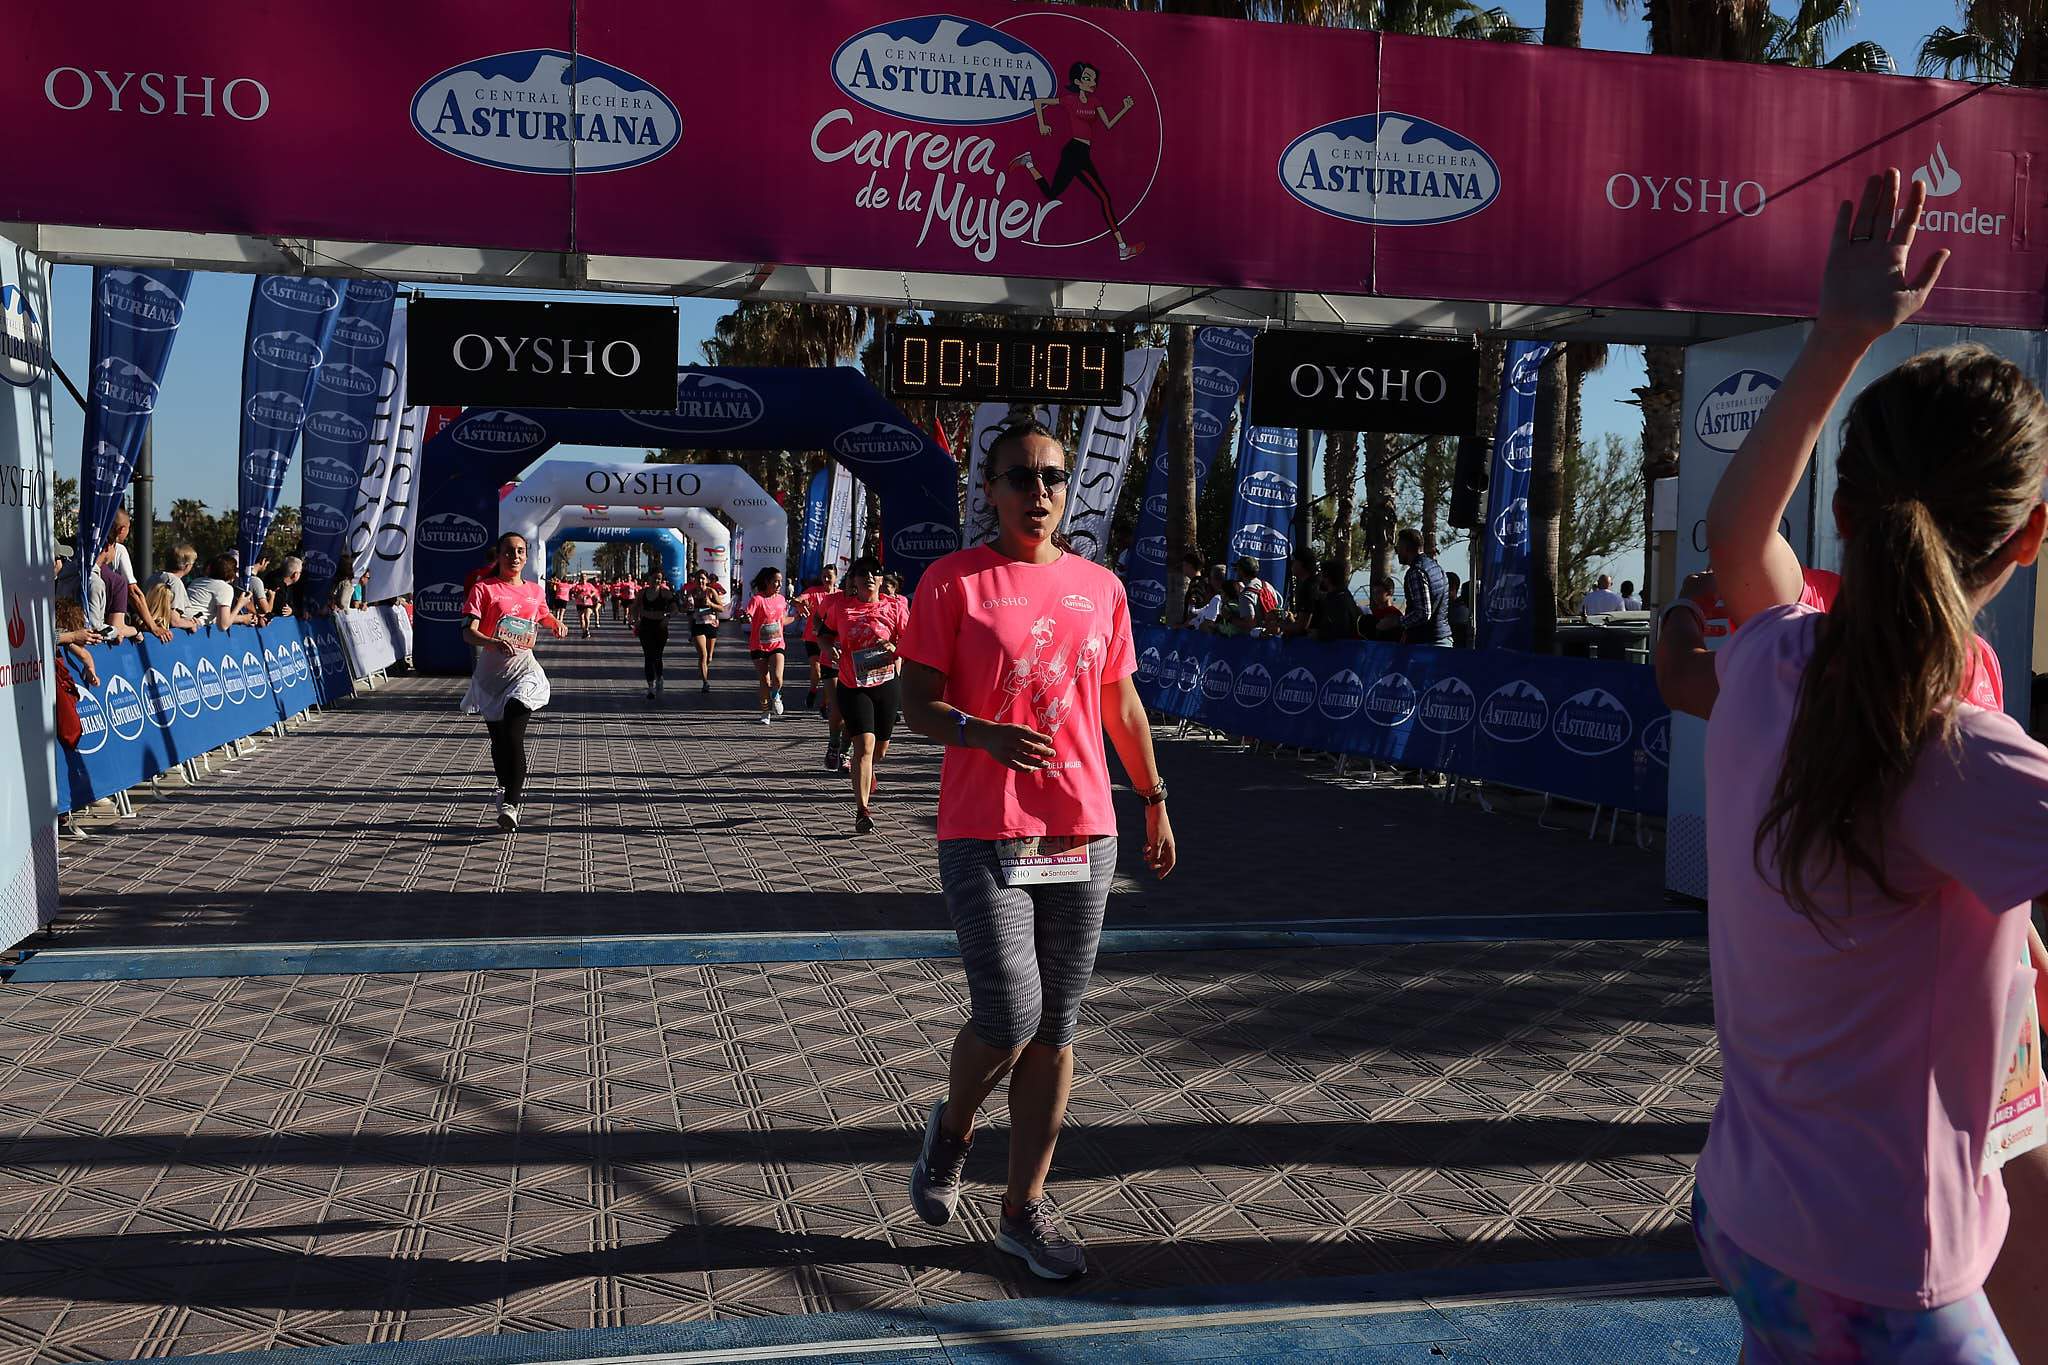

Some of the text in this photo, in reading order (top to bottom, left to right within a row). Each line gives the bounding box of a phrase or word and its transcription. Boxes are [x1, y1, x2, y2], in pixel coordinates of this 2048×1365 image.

[885, 48, 1033, 70] CENTRAL LECHERA
[849, 48, 1039, 102] ASTURIANA
[44, 66, 271, 122] OYSHO
[475, 88, 559, 104] CENTRAL
[432, 89, 662, 146] ASTURIANA
[810, 108, 995, 176] Carrera
[1331, 148, 1477, 167] CENTRAL LECHERA
[1296, 149, 1484, 200] ASTURIANA
[1605, 173, 1767, 217] OYSHO
[855, 171, 1064, 263] de la Mujer
[452, 333, 642, 377] OYSHO
[903, 337, 1106, 391] 00:41:04
[1290, 363, 1448, 404] OYSHO
[457, 424, 539, 444] ASTURIANA
[841, 438, 918, 453] ASTURIANA
[585, 471, 702, 496] OYSHO
[515, 495, 551, 505] OYSHO
[733, 498, 767, 506] OYSHO
[419, 526, 484, 544] ASTURIANA
[807, 500, 824, 552] Marlene
[750, 545, 782, 554] OYSHO
[895, 535, 956, 551] ASTURIANA
[982, 596, 1028, 609] OYSHO
[1421, 695, 1471, 721] ASTURIANA
[1482, 700, 1542, 730] ASTURIANA
[1555, 708, 1622, 743] ASTURIANA
[1020, 858, 1026, 866] DE
[1034, 857, 1053, 865] MUJER
